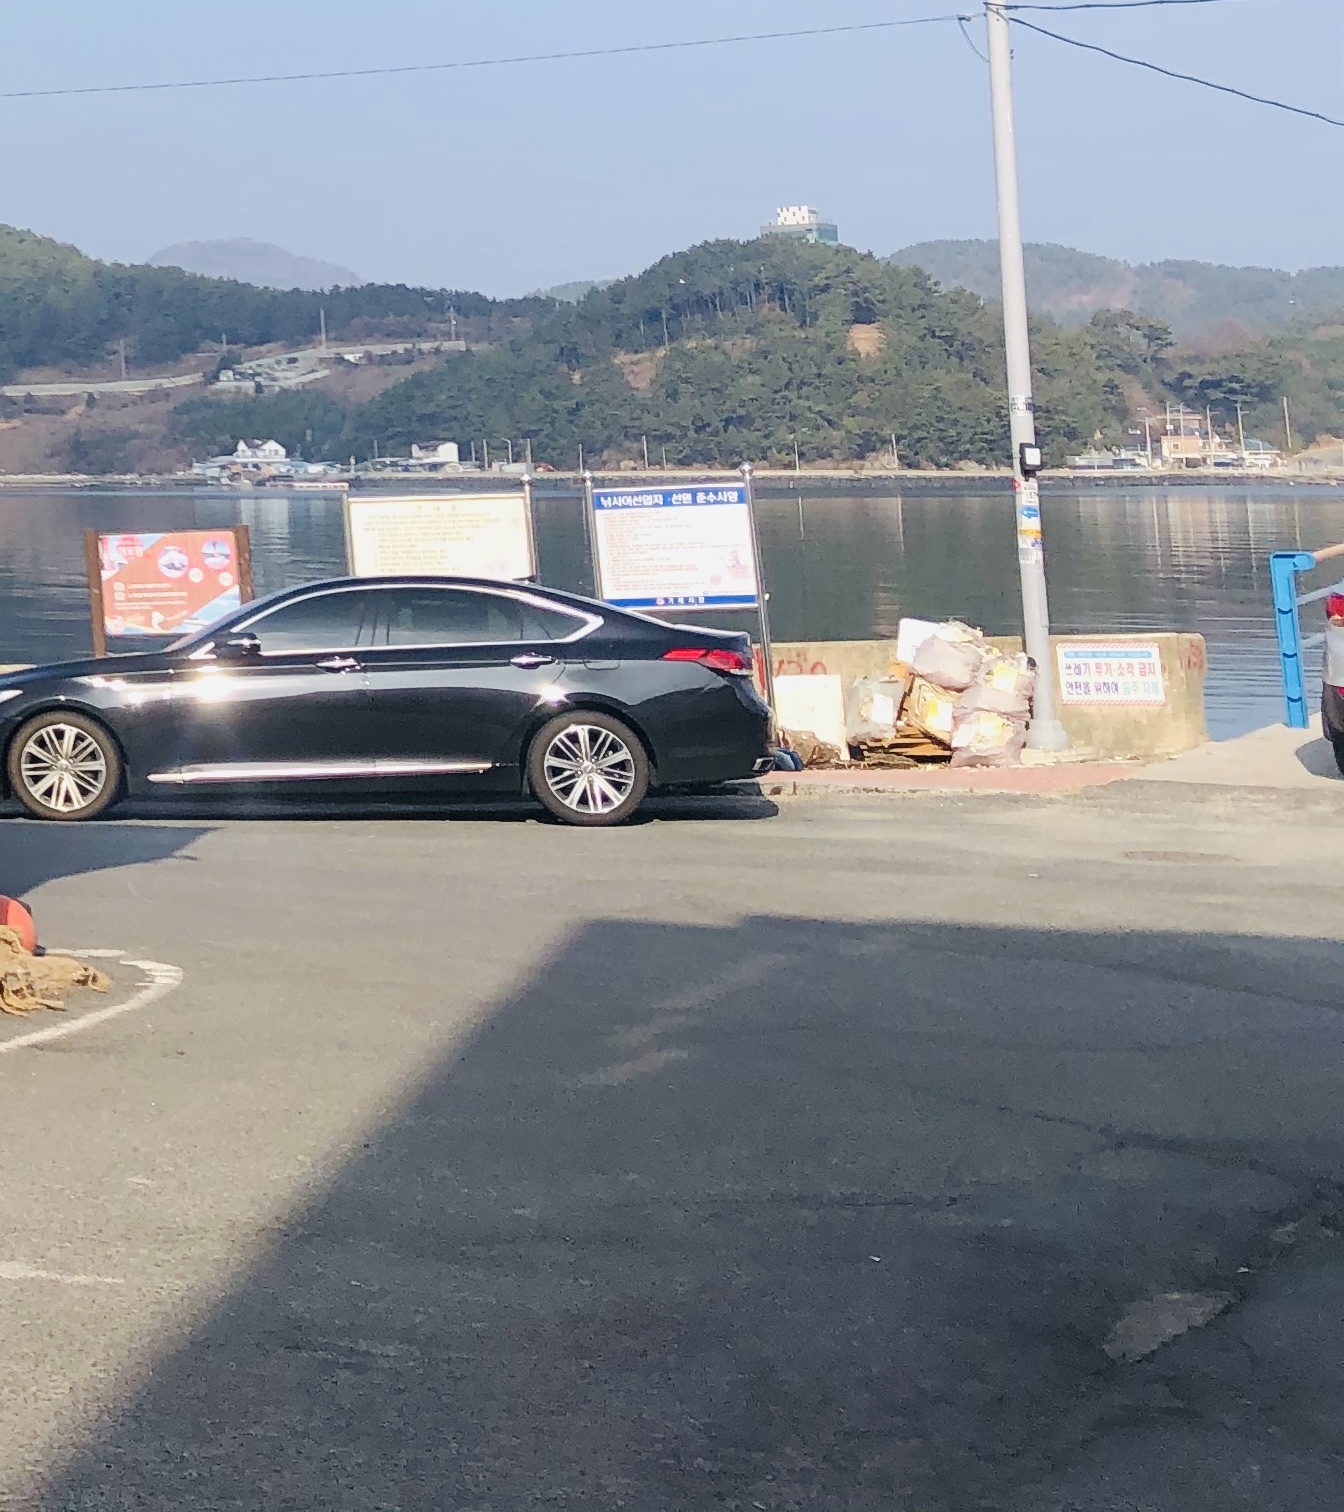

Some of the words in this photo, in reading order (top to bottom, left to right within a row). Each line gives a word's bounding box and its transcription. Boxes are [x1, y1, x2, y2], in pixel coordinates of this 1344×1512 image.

[1065, 662, 1091, 676] 쓰레기
[1138, 662, 1157, 677] 금지
[1065, 681, 1091, 696] 안전을
[1094, 681, 1120, 696] 위하여
[1123, 681, 1140, 696] 음주
